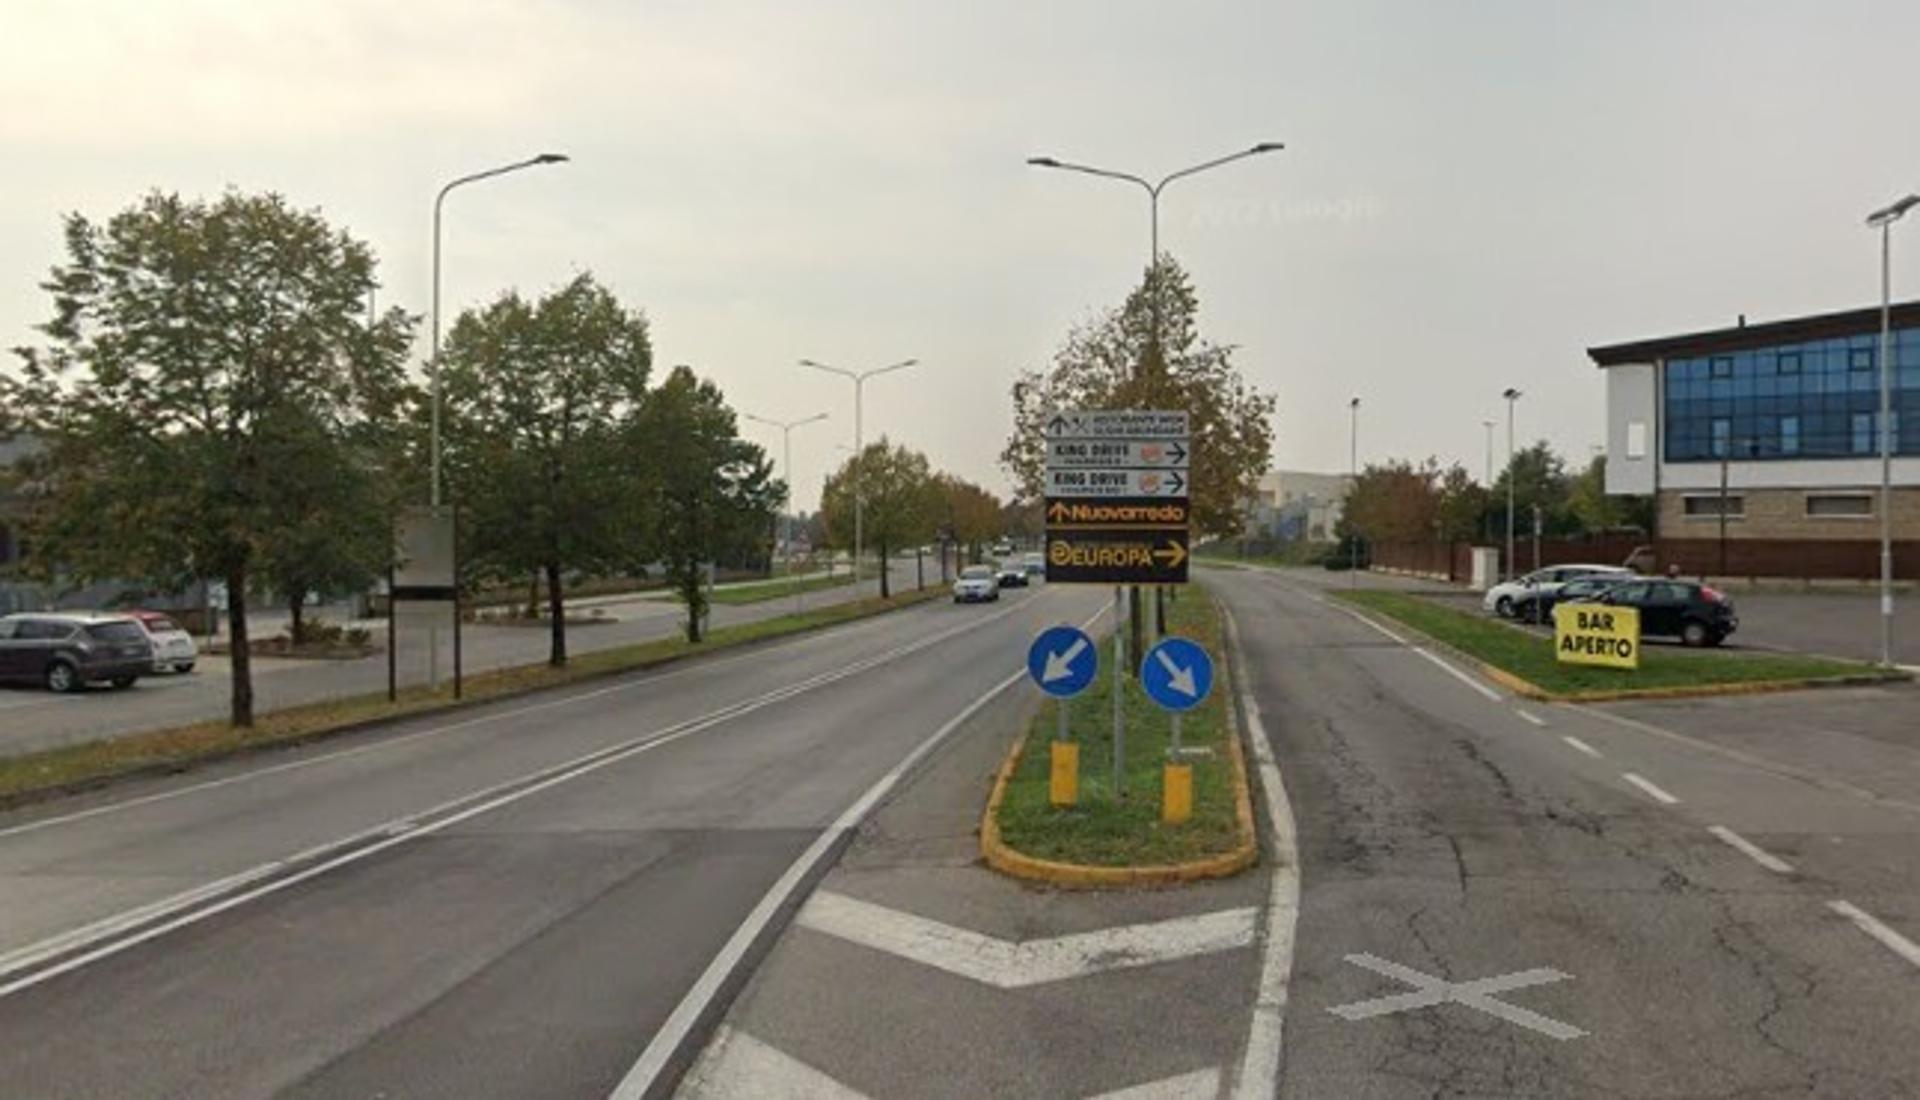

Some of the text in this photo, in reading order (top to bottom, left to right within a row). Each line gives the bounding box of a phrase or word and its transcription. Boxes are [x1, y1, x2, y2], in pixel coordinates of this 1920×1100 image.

[1054, 472, 1128, 485] KING DRIVE
[1577, 611, 1615, 632] BAR
[1560, 634, 1633, 658] APERTO
